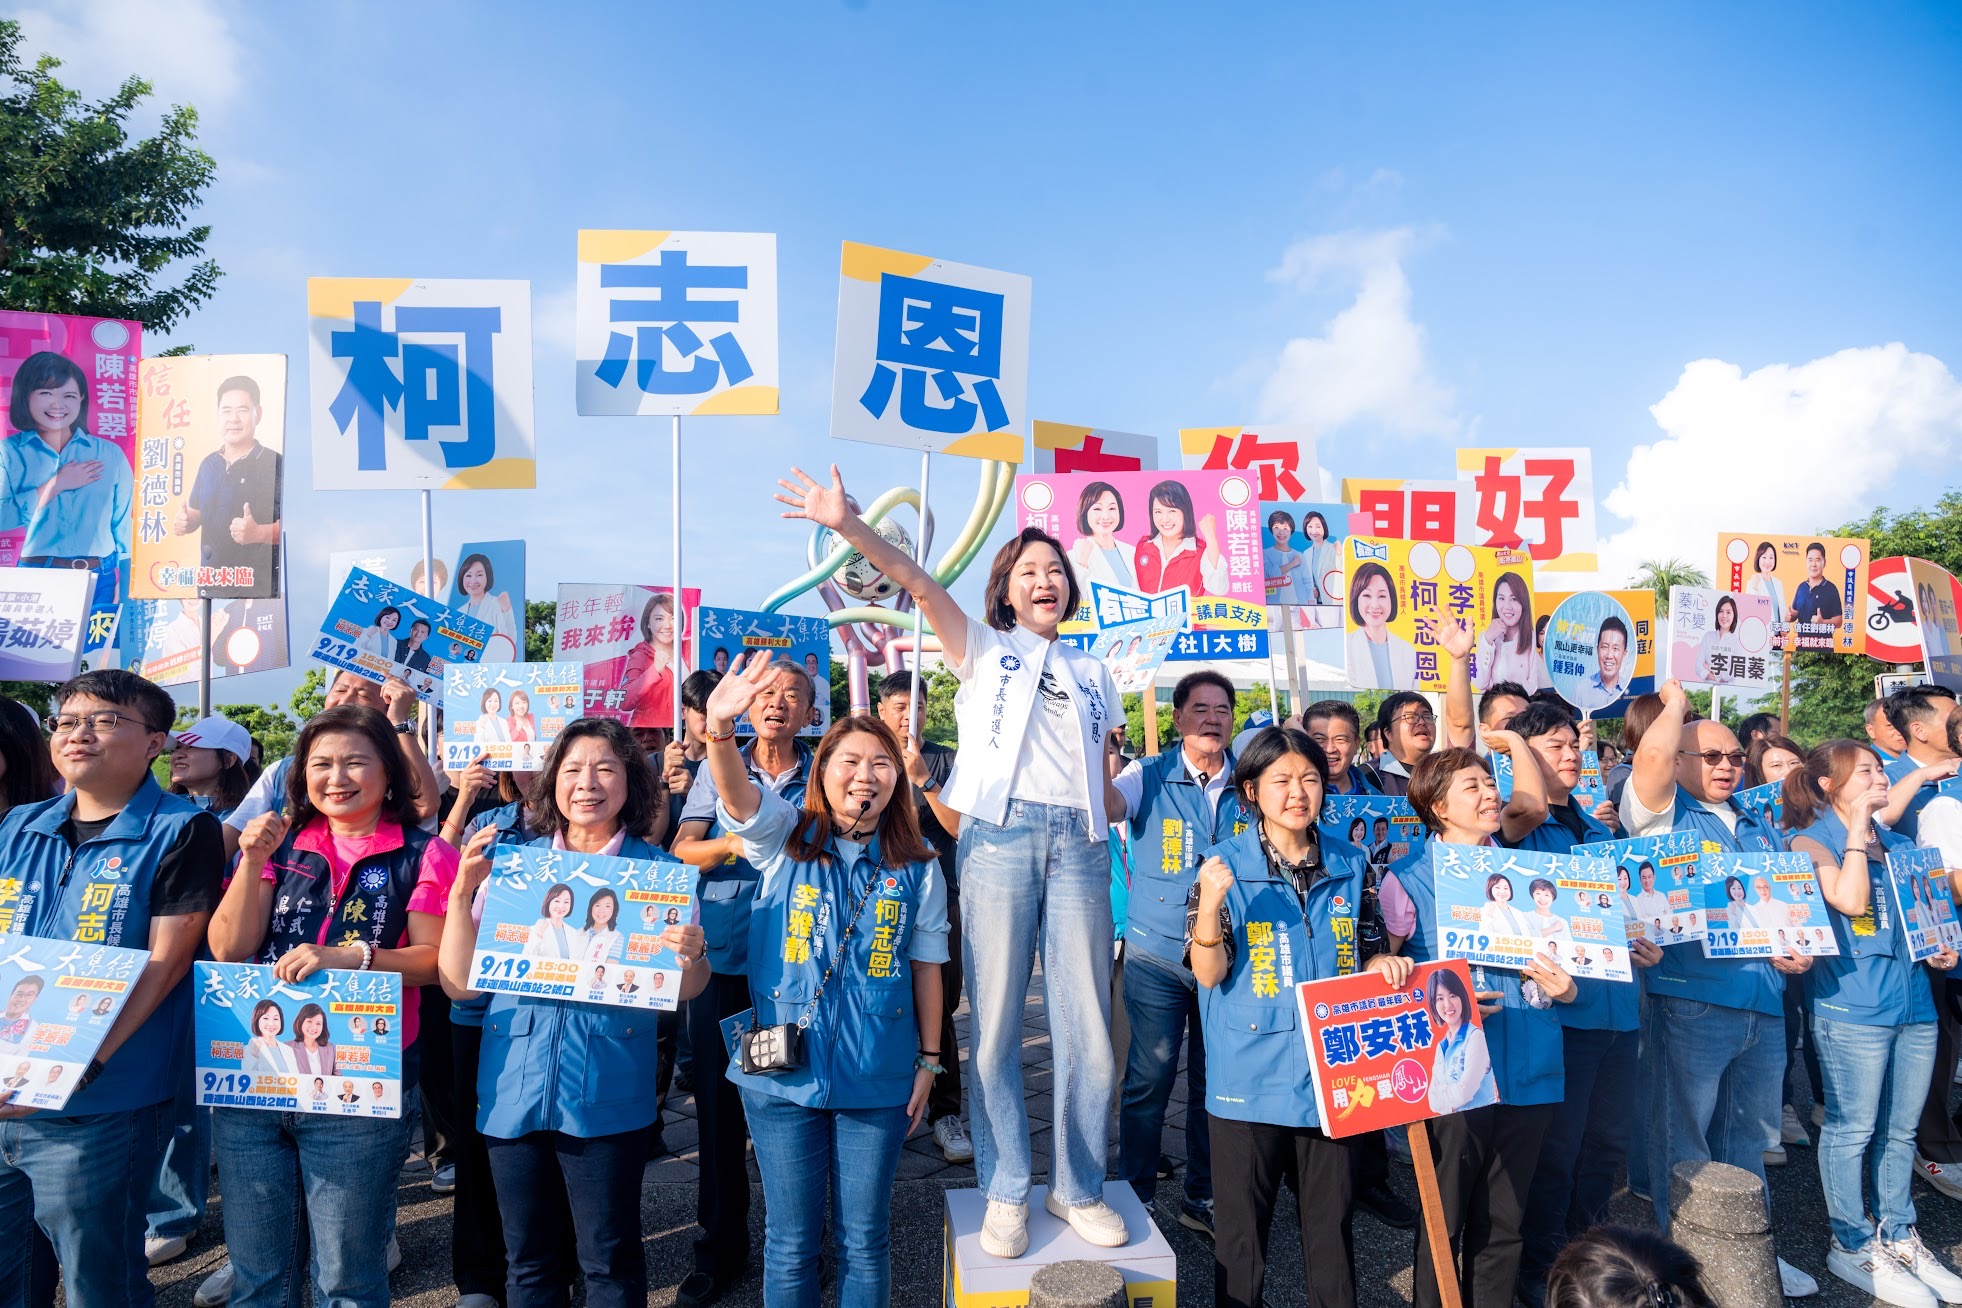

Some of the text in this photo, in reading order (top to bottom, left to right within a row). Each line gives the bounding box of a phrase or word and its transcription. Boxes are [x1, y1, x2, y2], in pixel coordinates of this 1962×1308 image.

[594, 251, 754, 395] 志
[859, 272, 1010, 434] 恩
[95, 353, 127, 439] 陳若翠
[143, 364, 190, 430] 信任
[328, 301, 501, 471] 柯
[1202, 434, 1306, 502] 你
[140, 438, 170, 543] 劉德林
[1475, 456, 1579, 560] 好
[1226, 510, 1251, 578] 陳若翠
[1250, 510, 1259, 575] 高雄市市議員候選人
[158, 566, 254, 587] 幸福就來臨
[1232, 582, 1253, 593] 懇託
[1399, 565, 1407, 615] 高雄市長候選人
[1478, 572, 1486, 627] 高雄市議員候選人
[0, 604, 54, 614] 議員參選人
[344, 574, 486, 640] 志家人 大集結
[560, 593, 624, 622] 我年輕
[1196, 603, 1262, 627] 議員支持
[88, 611, 116, 645] 來
[702, 609, 829, 645] 志家人 大集結
[1410, 580, 1440, 682] 柯志恩
[1678, 611, 1705, 630] 不變
[1770, 621, 1835, 634] 志恩 信任劉德林
[1843, 606, 1855, 648] 劉德林
[318, 637, 358, 660] 9/19
[746, 637, 789, 647] 高雄勝利大會
[1213, 634, 1257, 653] 大樹
[1554, 641, 1593, 656] 鳳山更幸福
[1770, 637, 1834, 648] 前行 幸福就來臨
[361, 653, 393, 669] 15:00
[1711, 653, 1765, 680] 李眉蓁
[447, 665, 523, 697] 志家人
[527, 664, 577, 686] 大集結
[584, 689, 626, 709] 于軒
[988, 673, 1011, 749] 市長候選人
[448, 745, 481, 759] 9/19
[485, 744, 512, 752] 15:00
[1325, 797, 1417, 824] 志家人 大集
[1162, 819, 1182, 874] 劉德林
[1582, 843, 1649, 863] 家人
[1651, 833, 1696, 858] 大集結
[495, 851, 689, 892] 志家人 大集結
[1441, 847, 1611, 881] 志家人 大集結
[1761, 853, 1808, 874] 大集結
[1561, 880, 1615, 891] 高雄勝利大會
[629, 892, 689, 904] 高雄勝利大會
[12, 895, 36, 935] 高雄市議
[71, 883, 116, 941] 柯志
[289, 897, 312, 935] 仁武
[784, 884, 820, 964] 李雅靜
[495, 930, 529, 943] 柯志恩
[1625, 921, 1645, 930] 5:00
[867, 899, 900, 978] 柯志恩
[1446, 931, 1489, 951] 9/19
[1495, 936, 1533, 947] 15:00
[1708, 931, 1738, 946] 9/19
[1911, 932, 1924, 949] 9/19
[52, 944, 135, 979] 大集結
[480, 955, 530, 979] 9/19
[536, 961, 579, 973] 15:00
[1246, 921, 1280, 998] 鄭安秝
[1278, 933, 1294, 988] 高雄市議員
[60, 977, 126, 991] 高雄勝利大會
[200, 967, 392, 1008] 志家人 大集結
[475, 977, 575, 996] 捷運鳳山西站2號口
[533, 971, 577, 983] 開放進場
[335, 1004, 395, 1013] 高雄勝利大會
[1332, 998, 1376, 1015] 高雄市議員
[1321, 1008, 1433, 1068] 鄭安秝
[211, 1048, 244, 1059] 柯志恩
[336, 1051, 370, 1063] 陳若翠
[204, 1072, 251, 1093] 9/19
[256, 1076, 298, 1086] 15:00
[1331, 1073, 1390, 1089] LOVE FENGSHAN
[203, 1093, 298, 1108] 捷運鳳山西站2號口
